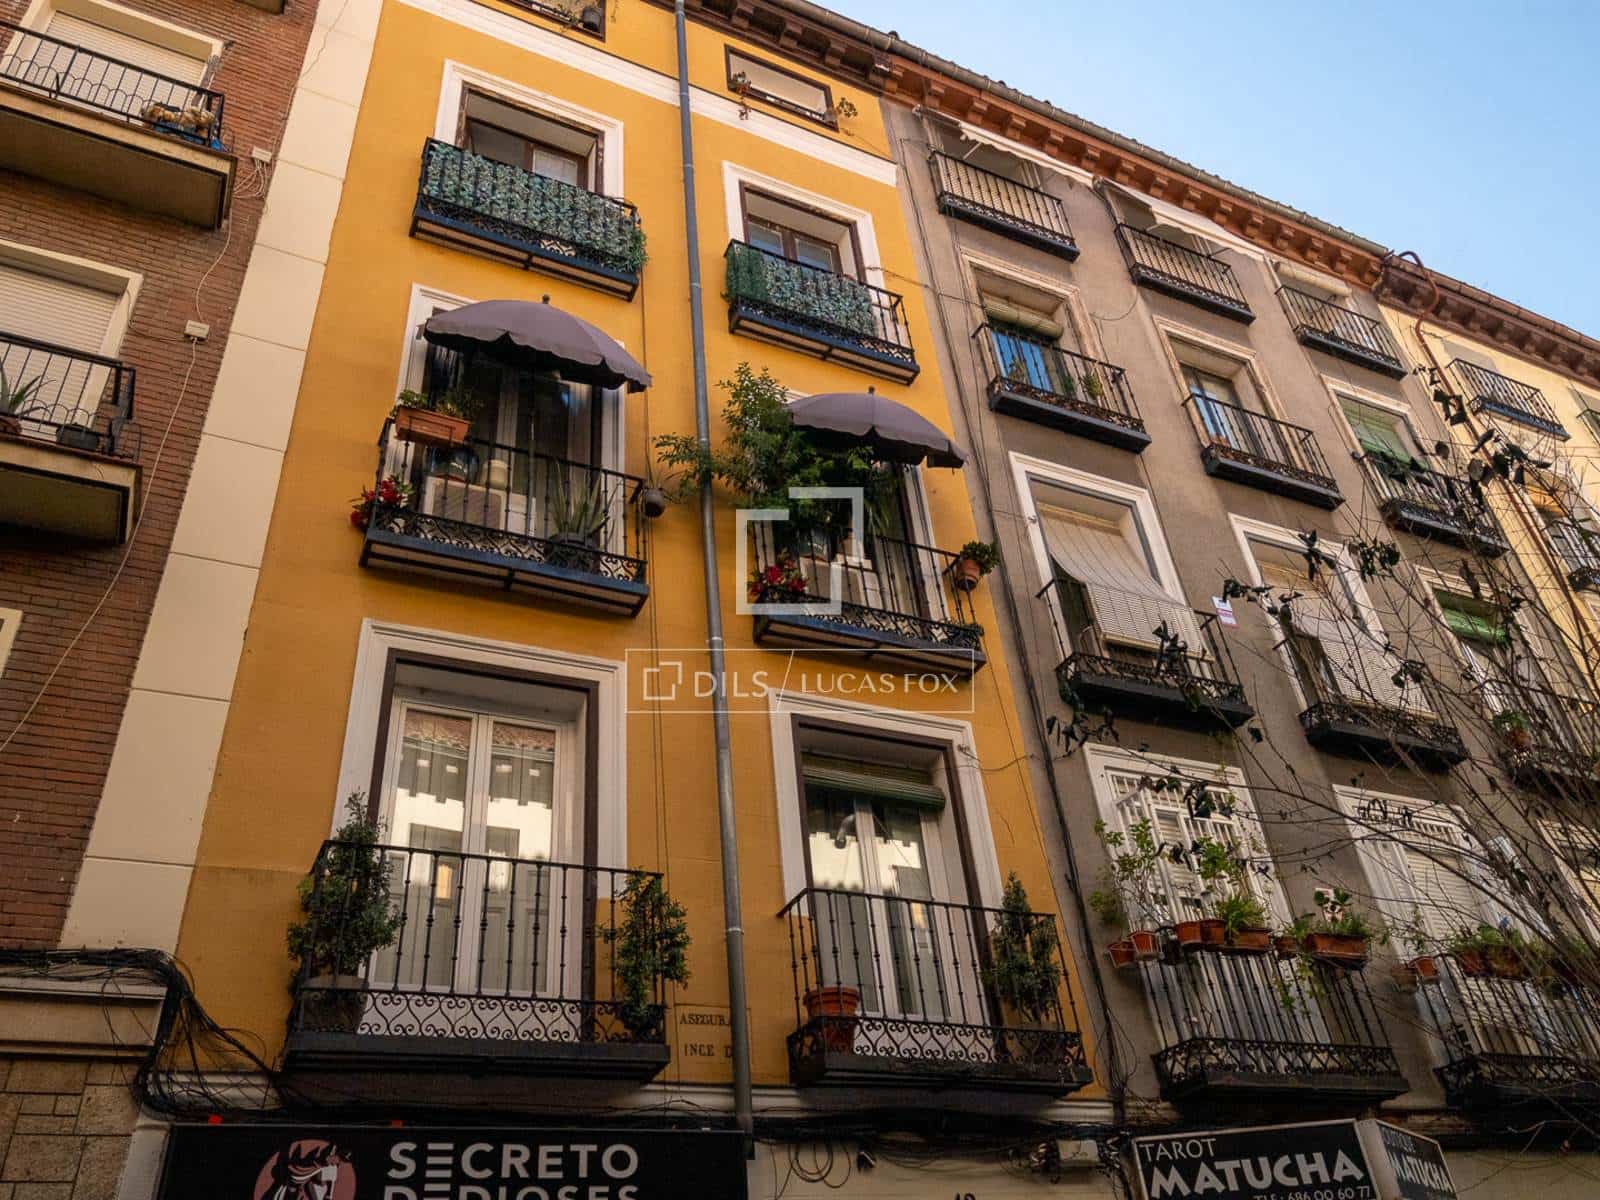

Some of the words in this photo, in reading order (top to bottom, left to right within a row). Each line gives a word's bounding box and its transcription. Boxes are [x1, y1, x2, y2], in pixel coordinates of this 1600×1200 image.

[680, 1012, 730, 1026] ASEGUR
[387, 1142, 639, 1179] SECRETO
[1138, 1138, 1216, 1162] TAROT
[1151, 1149, 1364, 1199] MATUCHA
